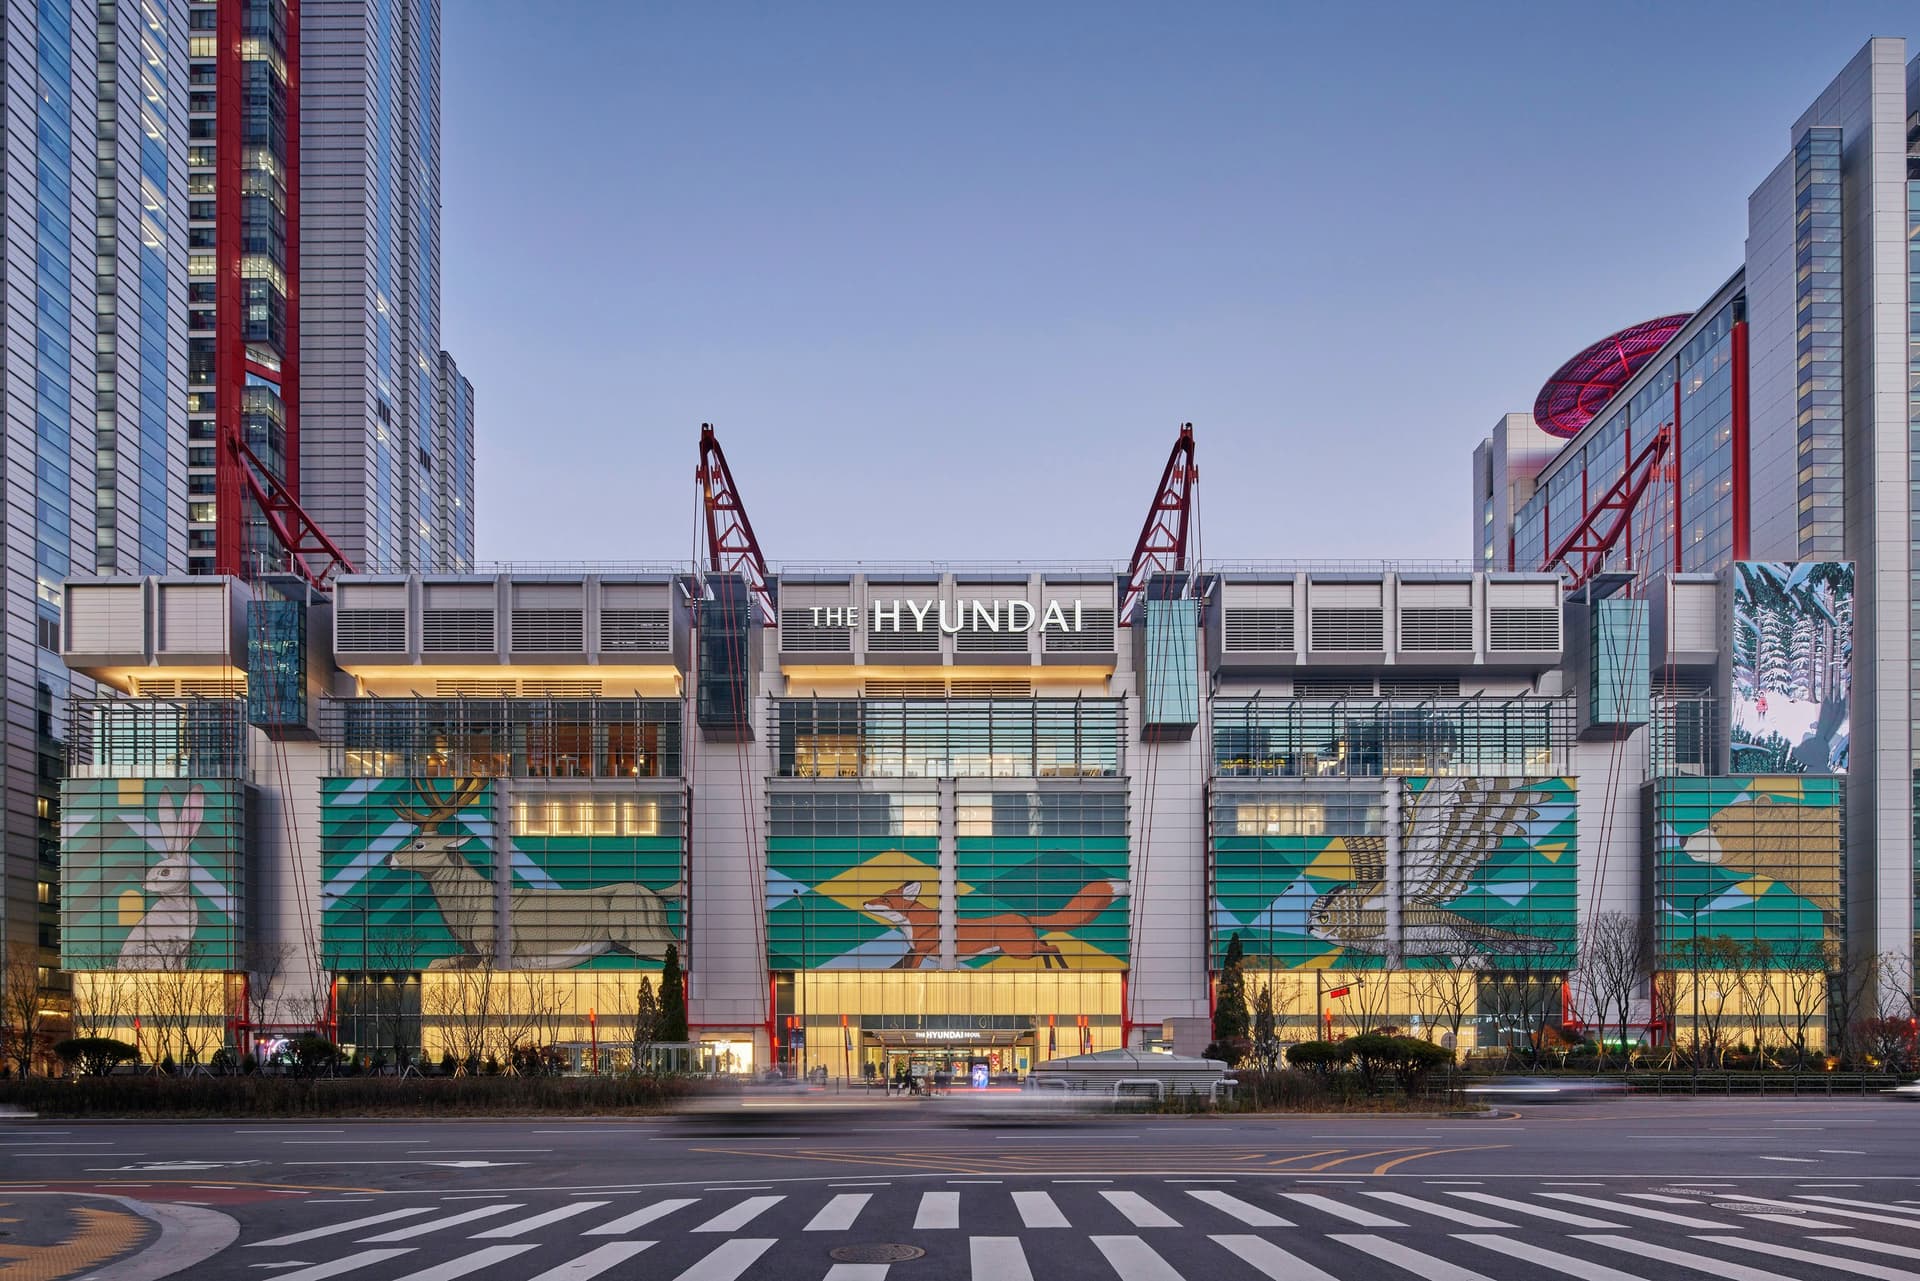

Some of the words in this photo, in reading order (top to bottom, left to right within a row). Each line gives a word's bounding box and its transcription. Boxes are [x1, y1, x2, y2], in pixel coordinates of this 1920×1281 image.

[809, 606, 859, 628] THE
[873, 599, 1082, 633] HYUNDAI
[926, 1031, 964, 1039] HYUNDAI
